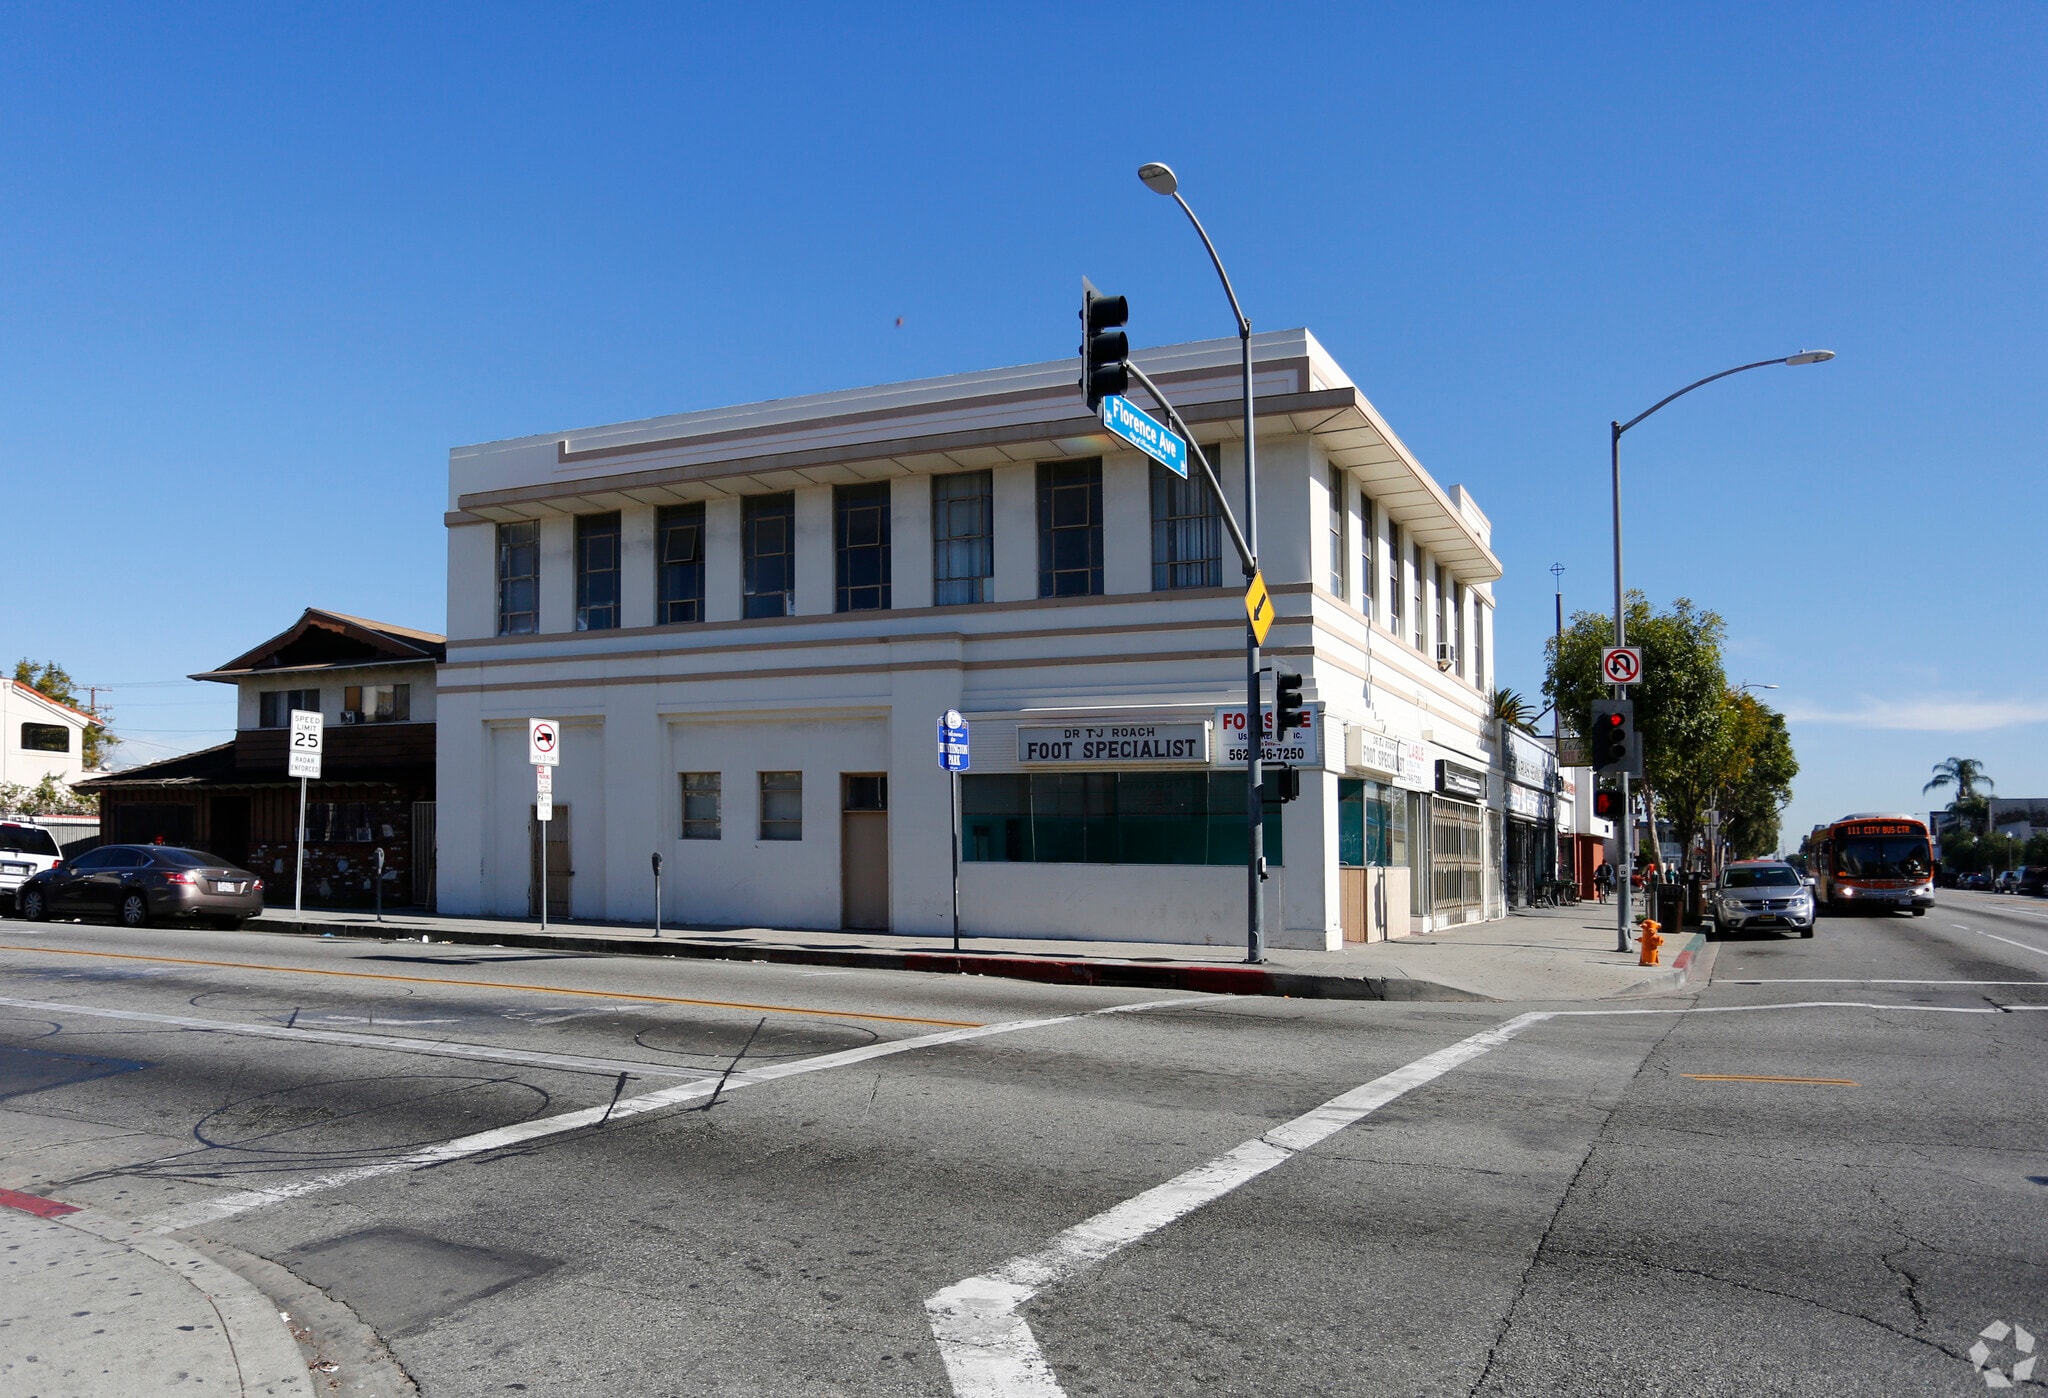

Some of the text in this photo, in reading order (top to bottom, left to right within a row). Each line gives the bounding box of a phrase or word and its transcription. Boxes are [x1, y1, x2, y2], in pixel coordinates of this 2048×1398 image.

[1113, 397, 1176, 458] Florence Ave
[295, 715, 320, 724] SPEED
[1223, 712, 1248, 730] FO
[297, 724, 317, 732] LIMIT
[1064, 729, 1080, 738] DR
[1112, 727, 1155, 738] ROACH
[295, 732, 318, 748] 25
[1027, 739, 1196, 760] FOOT SPECIALIST
[1363, 745, 1376, 765] FOOT
[295, 756, 315, 764] RADAR
[948, 754, 961, 766] PARK
[291, 764, 319, 773] ENFORCED
[1847, 825, 1910, 834] 111 CITY BUS CTR
